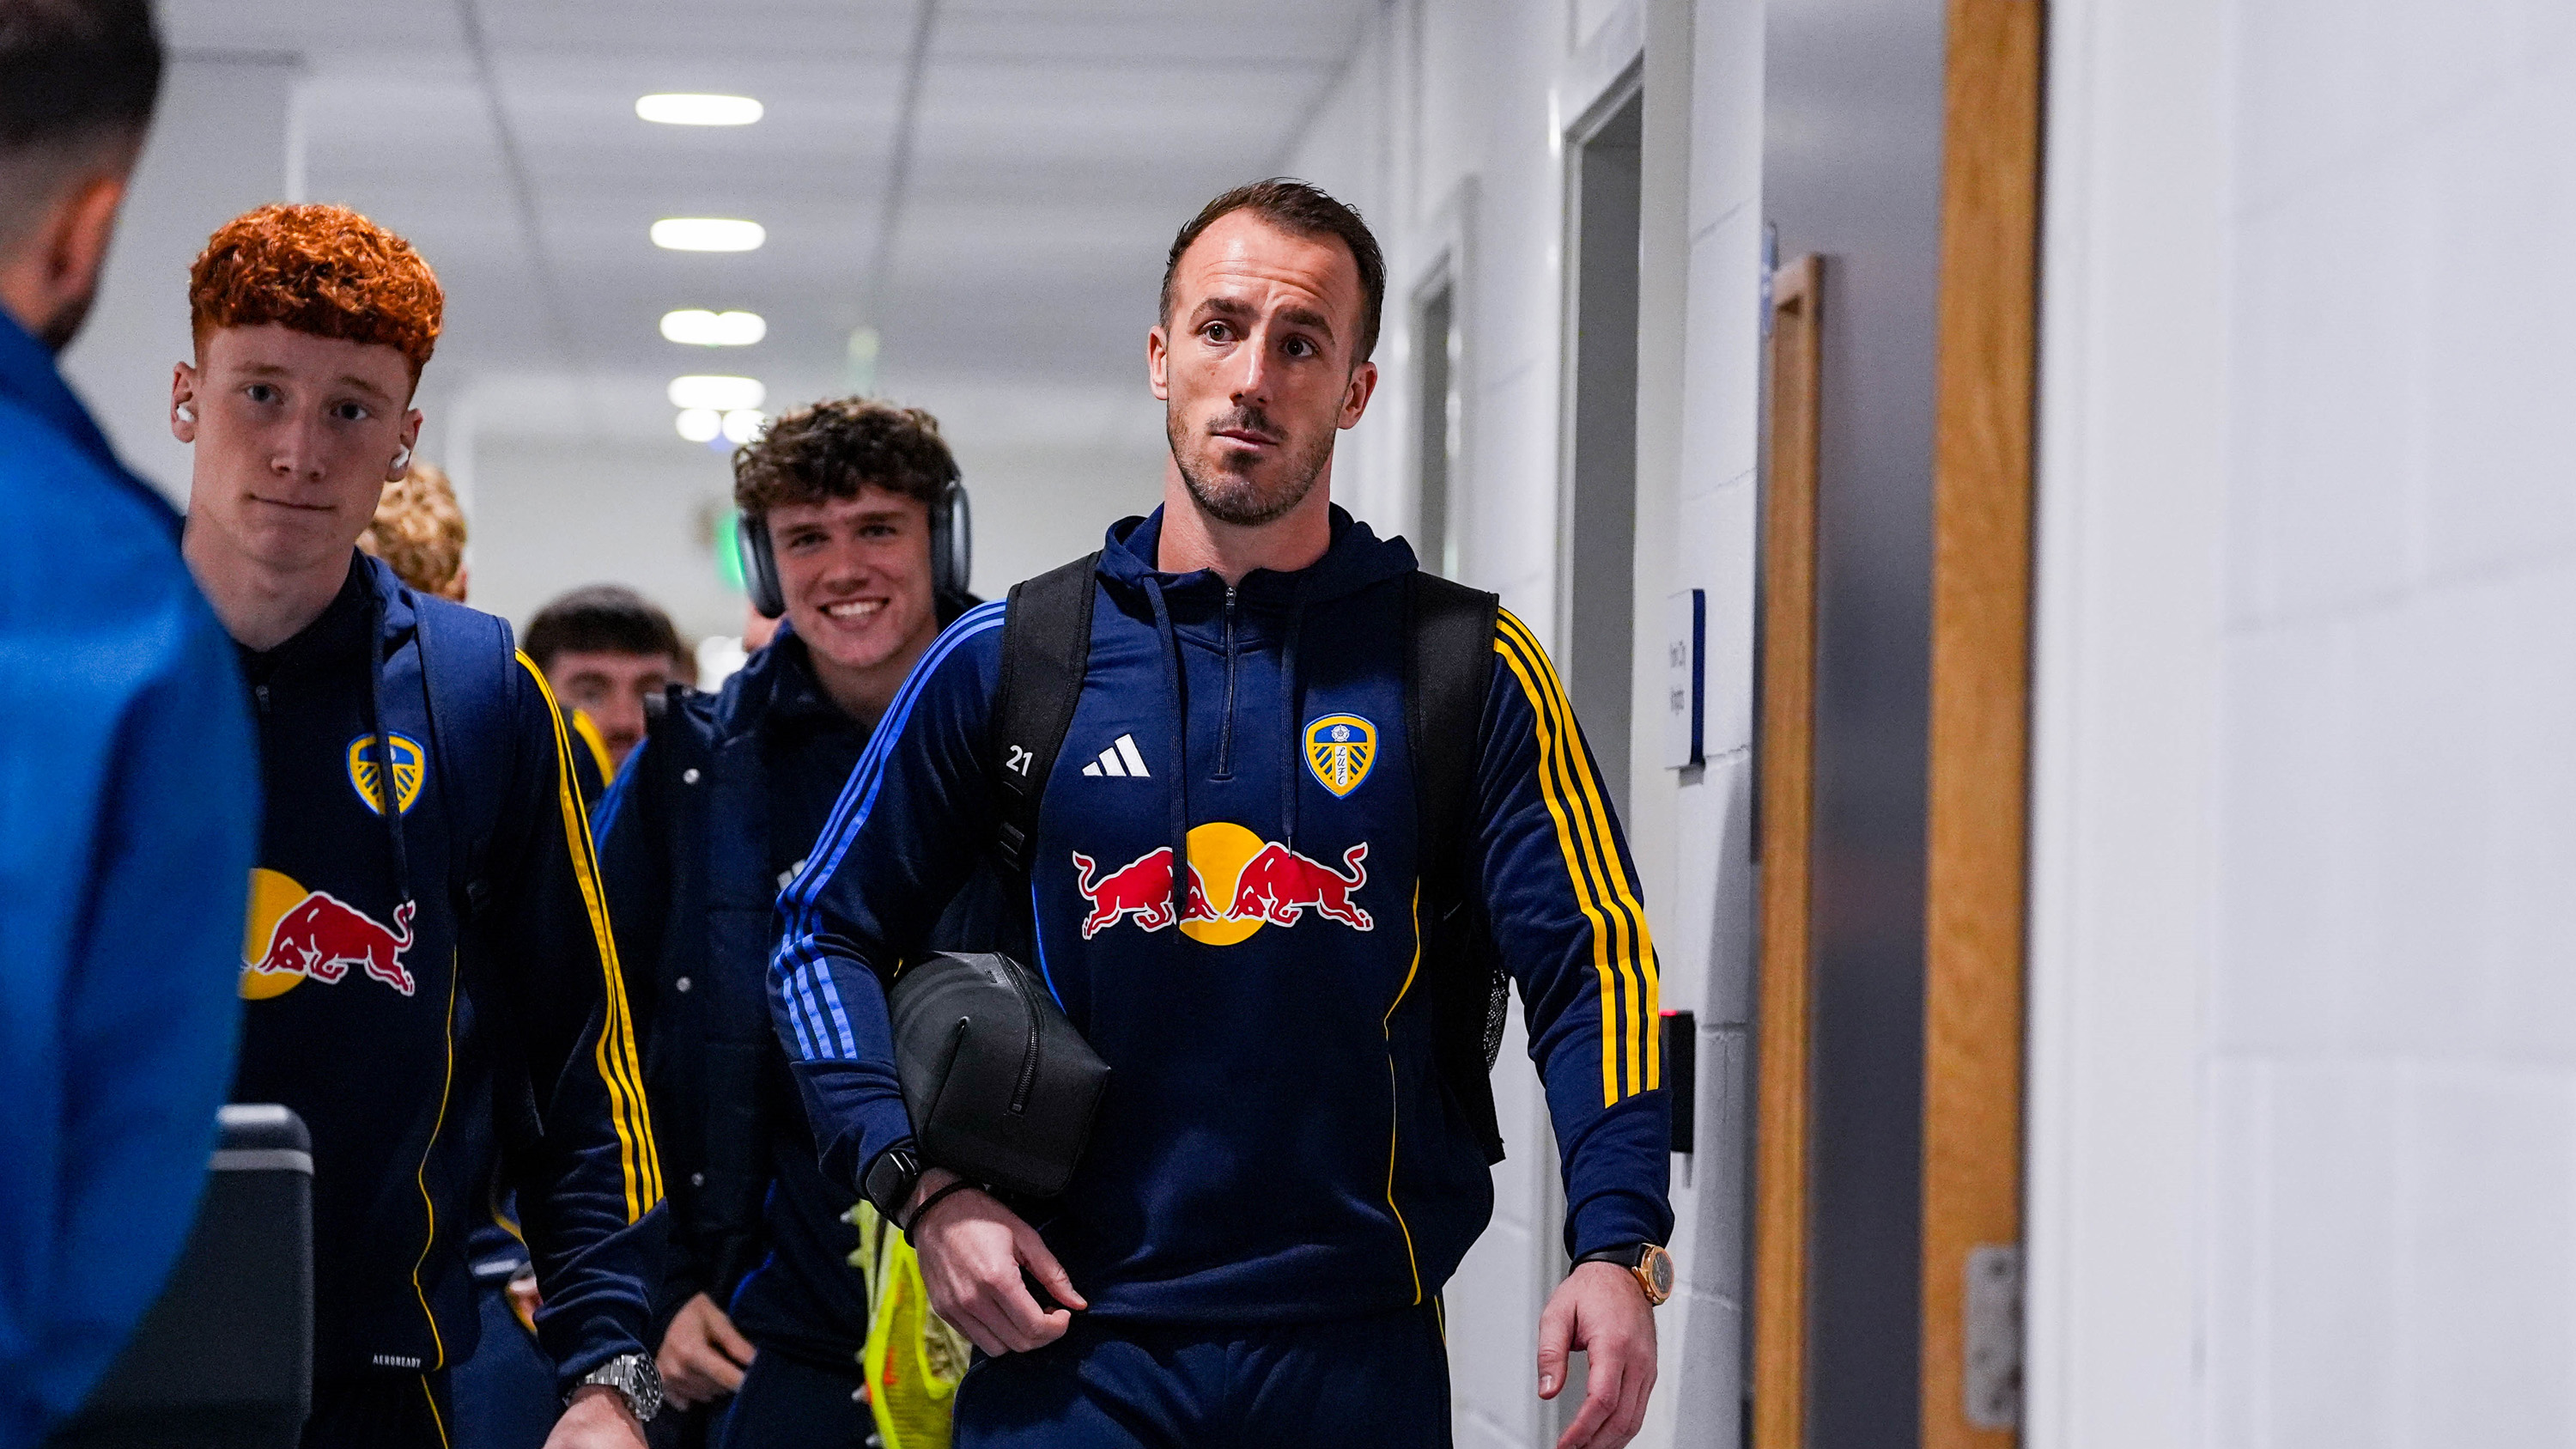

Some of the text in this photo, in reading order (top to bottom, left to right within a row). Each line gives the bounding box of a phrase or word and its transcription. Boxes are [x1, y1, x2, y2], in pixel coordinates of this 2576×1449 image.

[1005, 745, 1033, 777] 21
[1336, 746, 1346, 785] LUFC
[373, 1354, 422, 1368] AEROREADY
